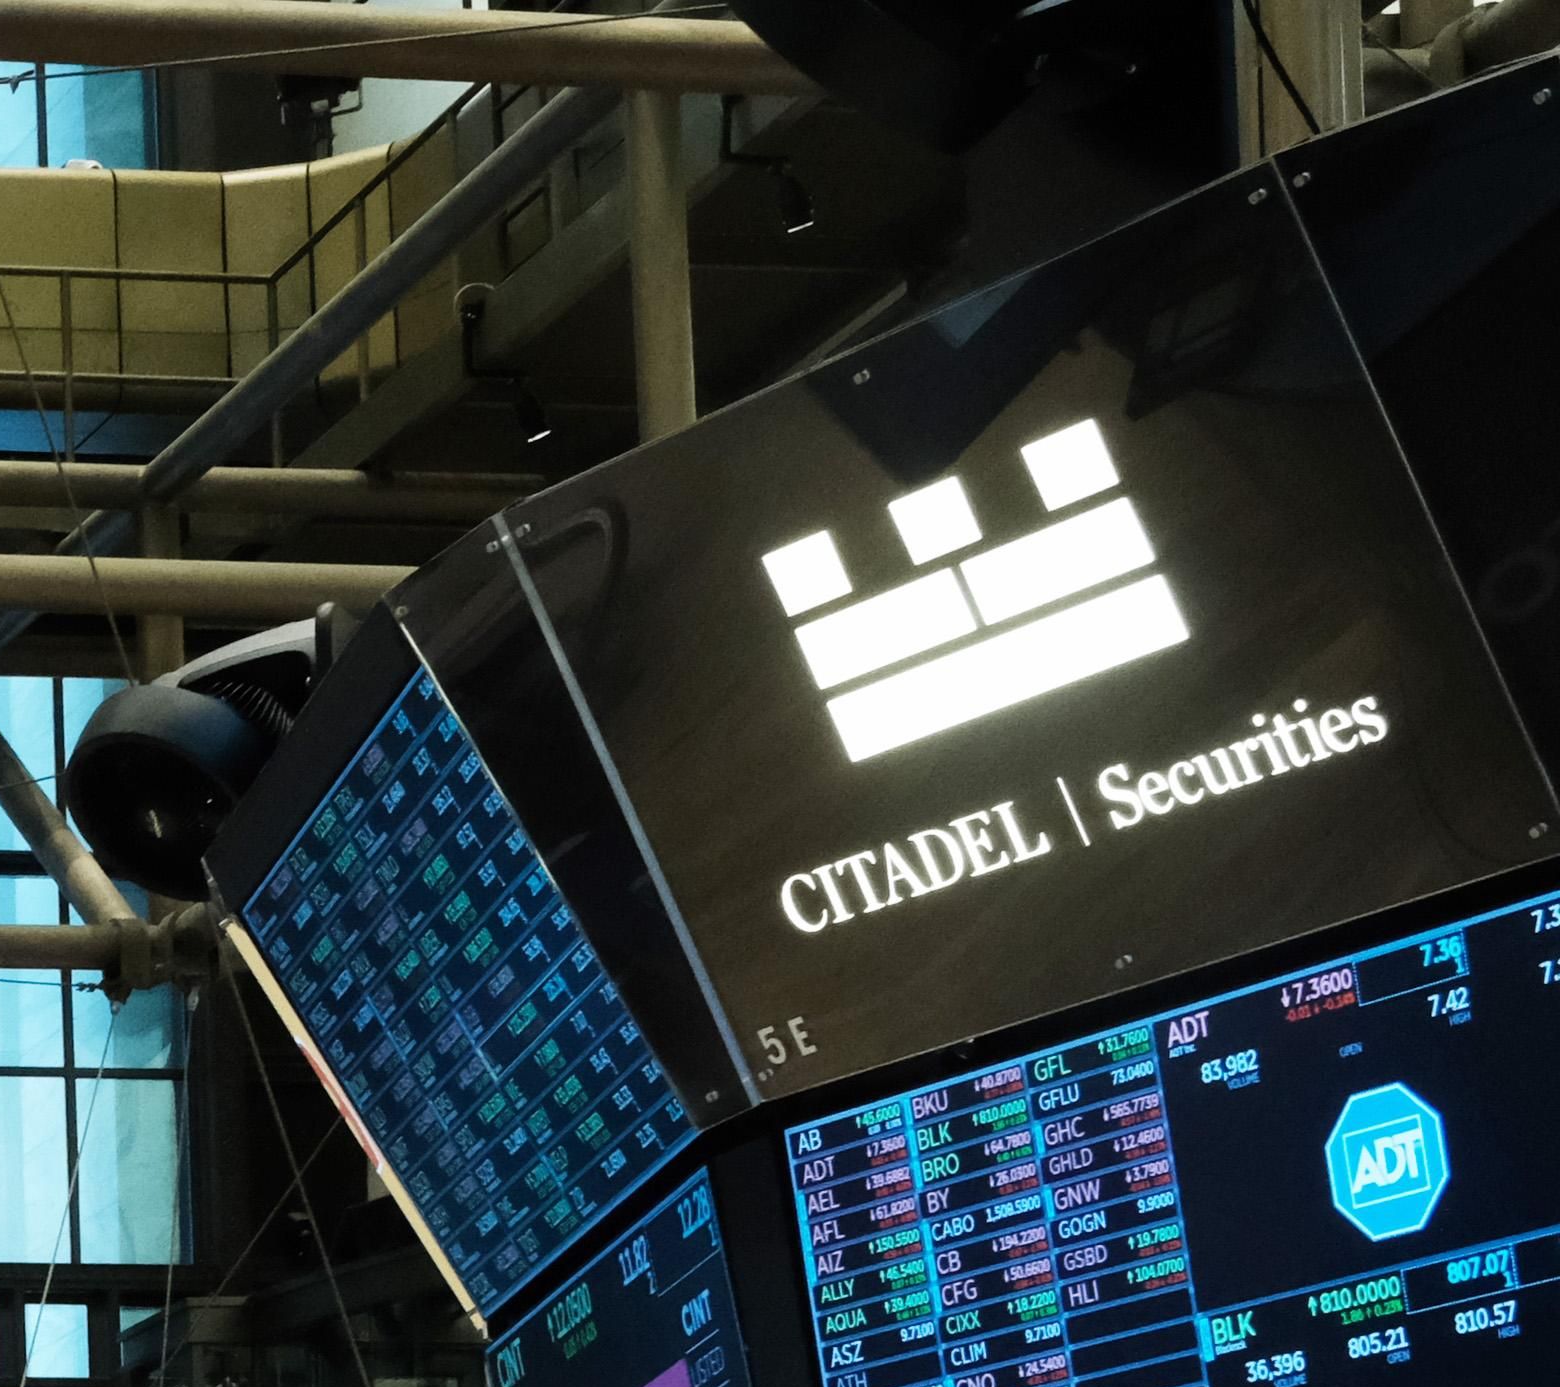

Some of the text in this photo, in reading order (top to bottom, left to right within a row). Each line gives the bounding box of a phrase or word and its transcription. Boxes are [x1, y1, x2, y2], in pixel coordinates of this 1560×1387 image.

[777, 694, 1391, 935] CITADEL Securities
[1291, 968, 1353, 1001] 7.3600
[1427, 986, 1471, 1018] 7.42
[1168, 1010, 1211, 1049] ADT
[1033, 1053, 1072, 1083] GFL
[1201, 1048, 1260, 1085] 83,982
[921, 1152, 960, 1183] BRO
[1351, 1127, 1422, 1195] ADT
[931, 1214, 976, 1243] CABO
[1058, 1210, 1108, 1240] GOGN
[1446, 1249, 1510, 1284] 807.07
[820, 1278, 856, 1305] ALLY
[1320, 1275, 1401, 1314] 810.0000
[680, 1288, 712, 1338] CINT
[825, 1310, 867, 1335] AQUA
[1211, 1310, 1257, 1345] BLK
[1454, 1299, 1517, 1335] 810.57
[1348, 1326, 1410, 1359] 805.21
[1245, 1350, 1307, 1384] 36,396
